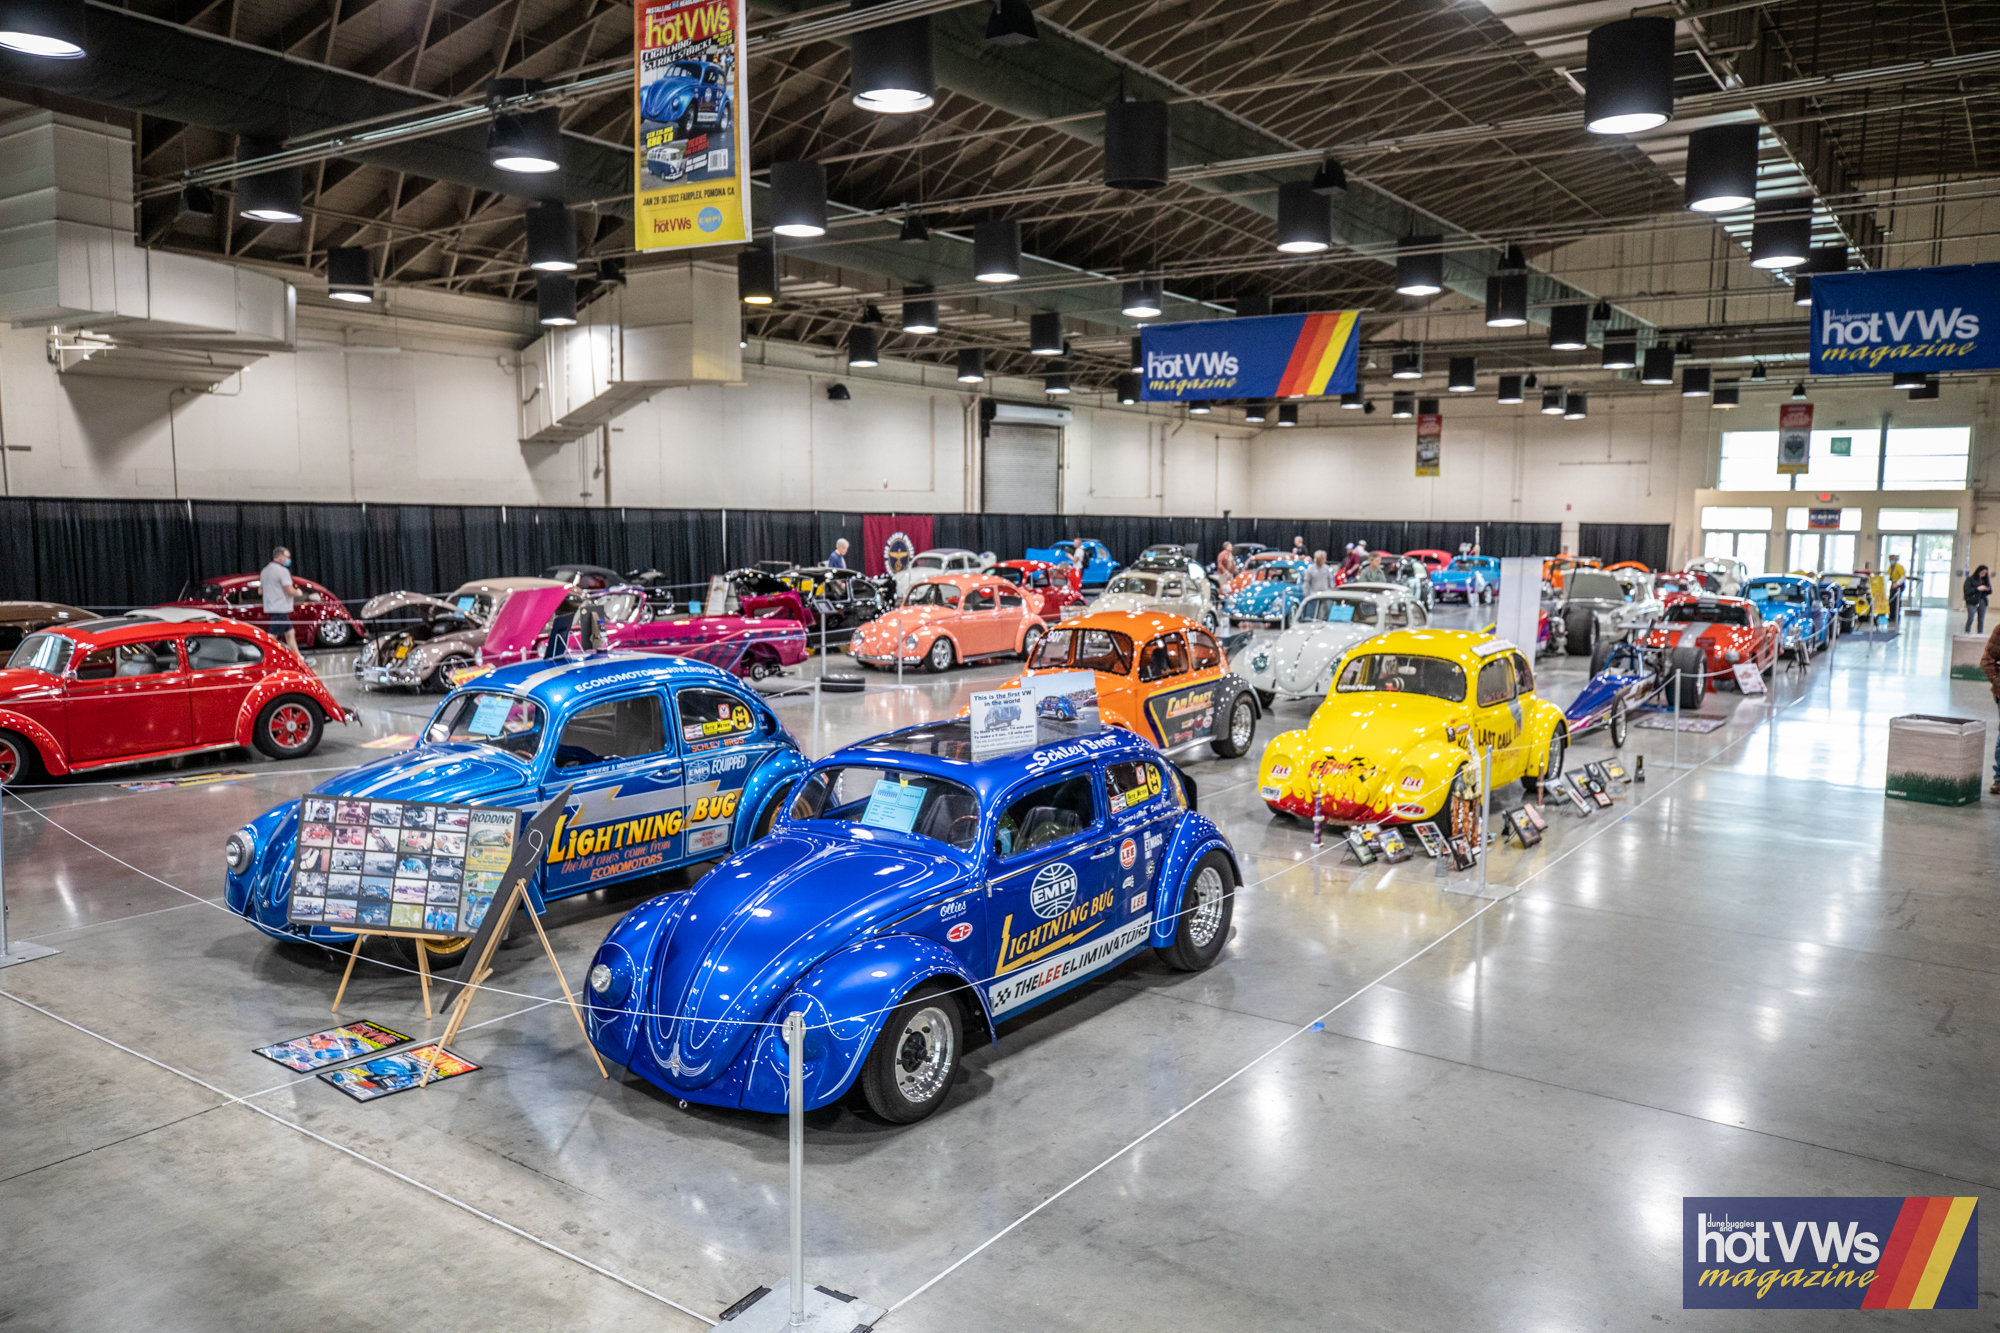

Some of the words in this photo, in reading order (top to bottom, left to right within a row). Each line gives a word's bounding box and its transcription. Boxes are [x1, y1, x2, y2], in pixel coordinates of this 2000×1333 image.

[647, 13, 683, 47] hot
[683, 2, 730, 39] VWs
[642, 38, 692, 61] LIGHTNING
[642, 197, 653, 206] JAN
[704, 187, 726, 198] POMONA
[727, 186, 736, 195] CA
[653, 218, 669, 233] hot
[669, 216, 692, 231] VWs
[1821, 308, 1883, 346] hot
[1884, 307, 1980, 342] VWs
[1820, 339, 1978, 369] magazine
[1147, 351, 1184, 379] hot
[1183, 351, 1239, 377] VWs
[1148, 374, 1238, 397] magazine
[1003, 697, 1021, 705] world
[1167, 696, 1188, 718] CAR
[691, 740, 720, 753] SCHLEY
[723, 736, 746, 747] BROS.
[1478, 728, 1496, 749] LAST
[1033, 744, 1090, 767] Schley
[1080, 735, 1122, 751] Bros.
[688, 767, 710, 777] EMPI
[711, 754, 748, 775] EQUIPPED
[1271, 764, 1290, 775] fat
[1401, 775, 1421, 787] fat
[691, 792, 737, 822] BUG
[471, 812, 514, 825] RODDING
[561, 859, 578, 874] the
[624, 844, 649, 859] come
[650, 840, 671, 853] from
[1121, 847, 1135, 860] LEE
[590, 852, 663, 881] ECONOMOTORS
[1032, 877, 1076, 906] EMPI
[1132, 894, 1145, 910] LEE
[940, 900, 967, 917] Ollies
[994, 902, 1089, 979] LIGHTNING
[1090, 888, 1114, 918] BUG
